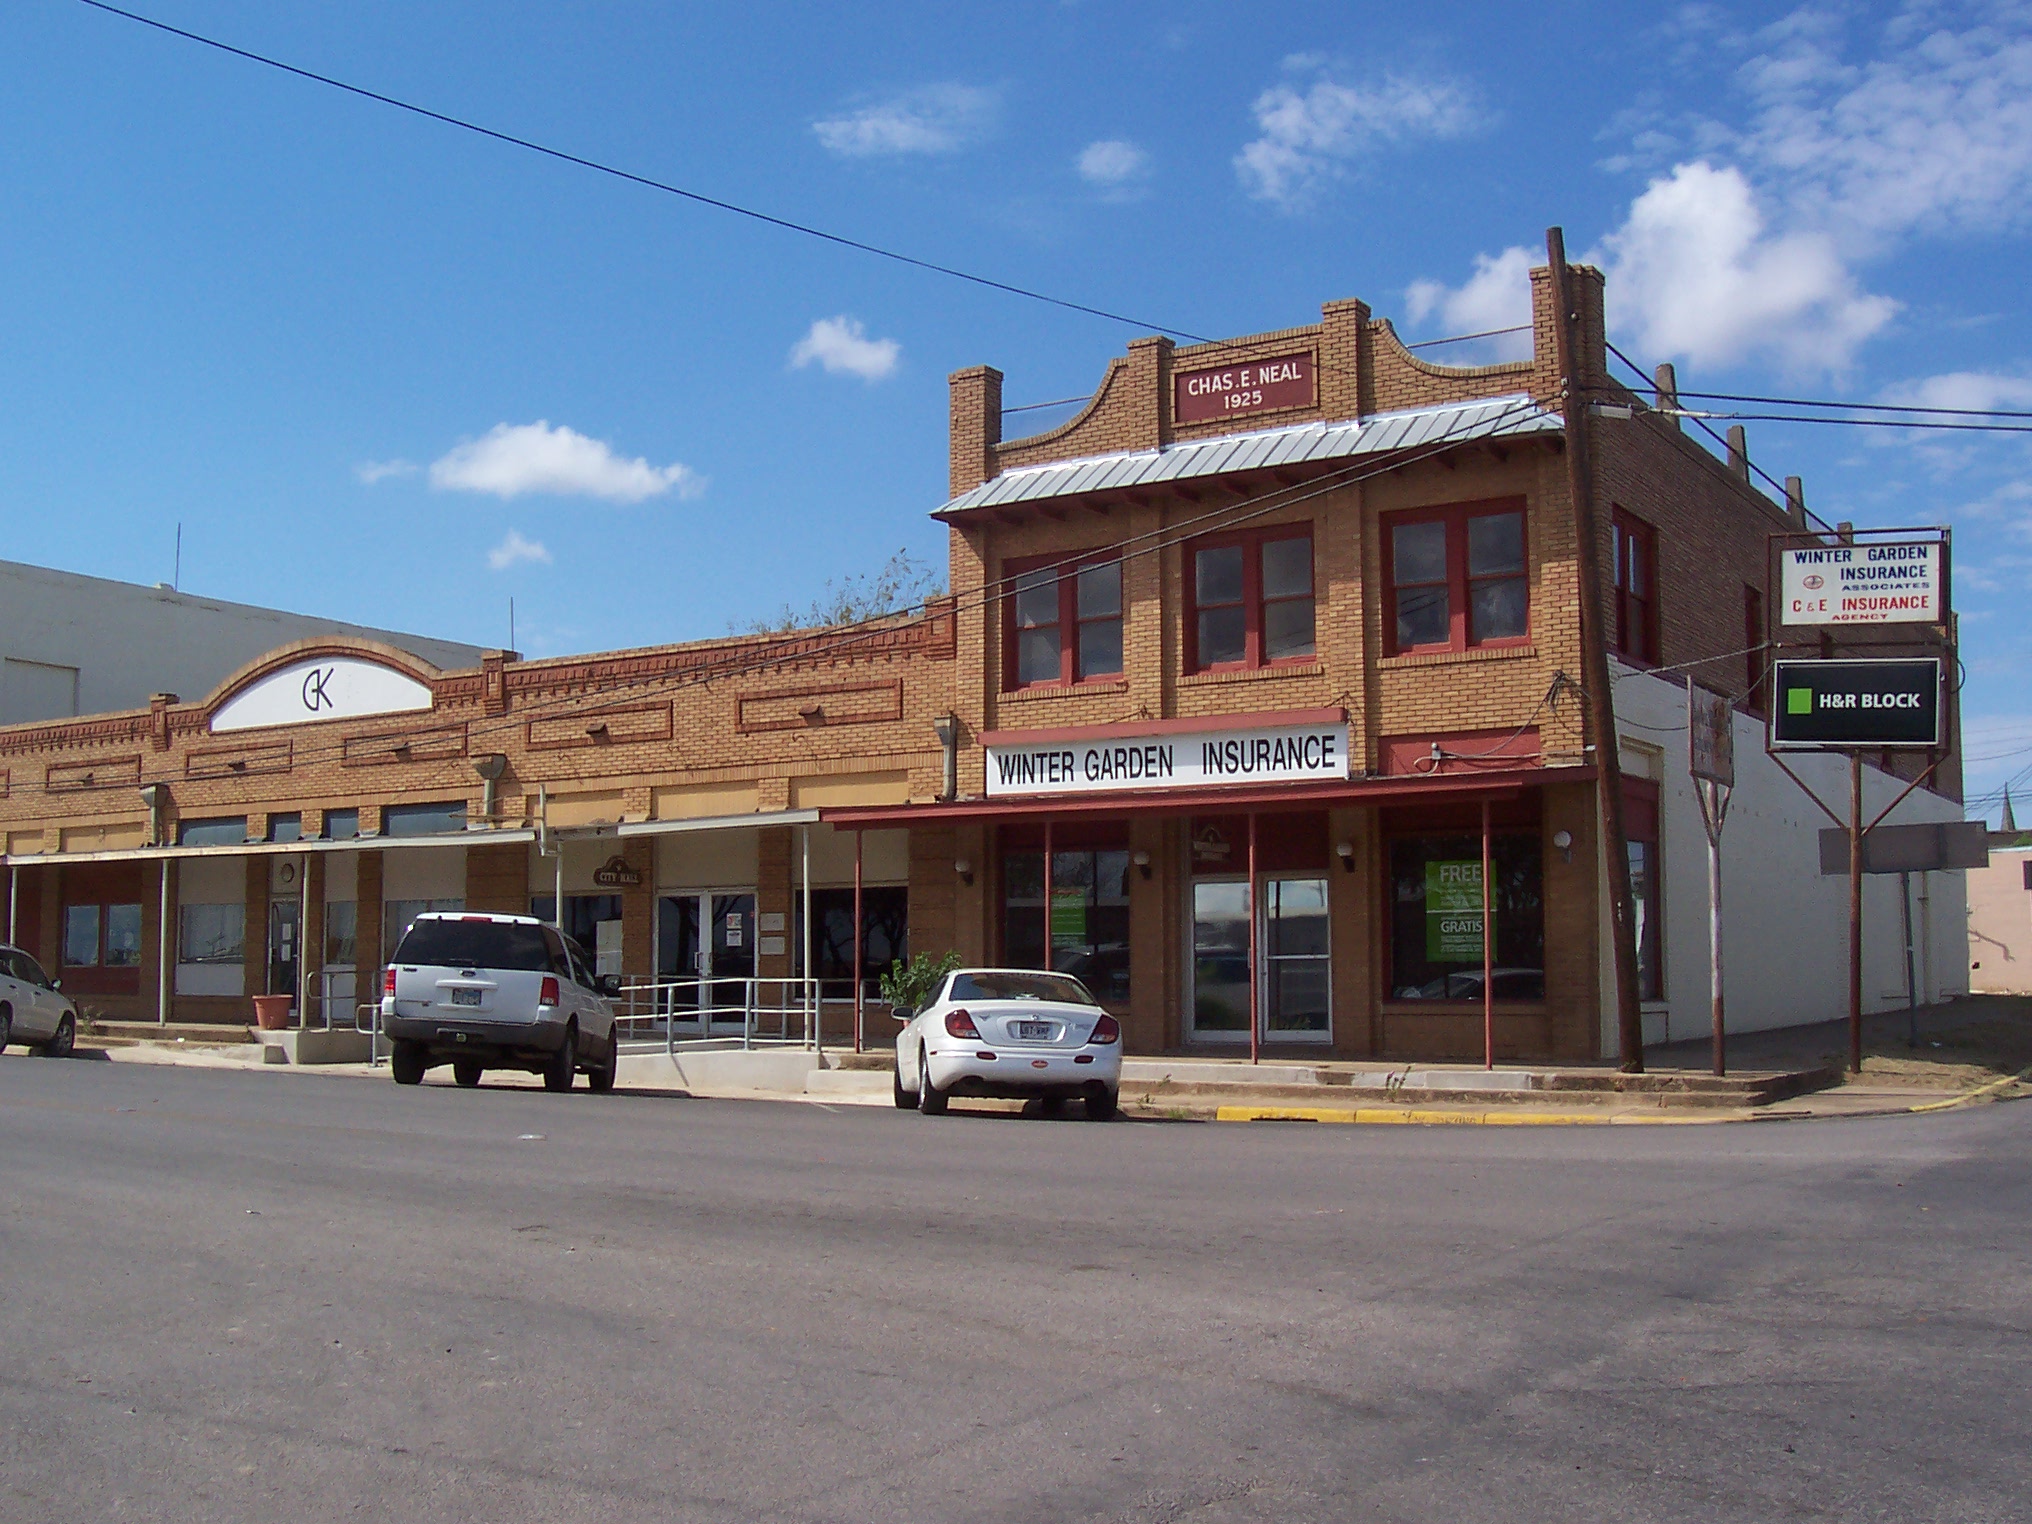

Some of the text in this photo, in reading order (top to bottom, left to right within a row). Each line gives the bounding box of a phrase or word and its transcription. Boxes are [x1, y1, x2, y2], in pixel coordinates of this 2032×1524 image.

[1259, 362, 1302, 384] NEAL
[1224, 390, 1263, 410] 1925
[1795, 546, 1928, 564] WINTER GARDEN
[1840, 565, 1927, 580] INSURANCE
[1841, 582, 1930, 591] ASSOCIATES
[1793, 600, 1802, 612] C
[1819, 599, 1828, 611] E
[1842, 596, 1929, 611] INSURANCE
[1832, 613, 1889, 621] AGENCY
[1819, 693, 1921, 708] H&R BLOCK
[998, 735, 1336, 785] WINTER GARDEN INSURANCE
[1440, 864, 1482, 882] FREE
[1440, 920, 1483, 933] GRATIS
